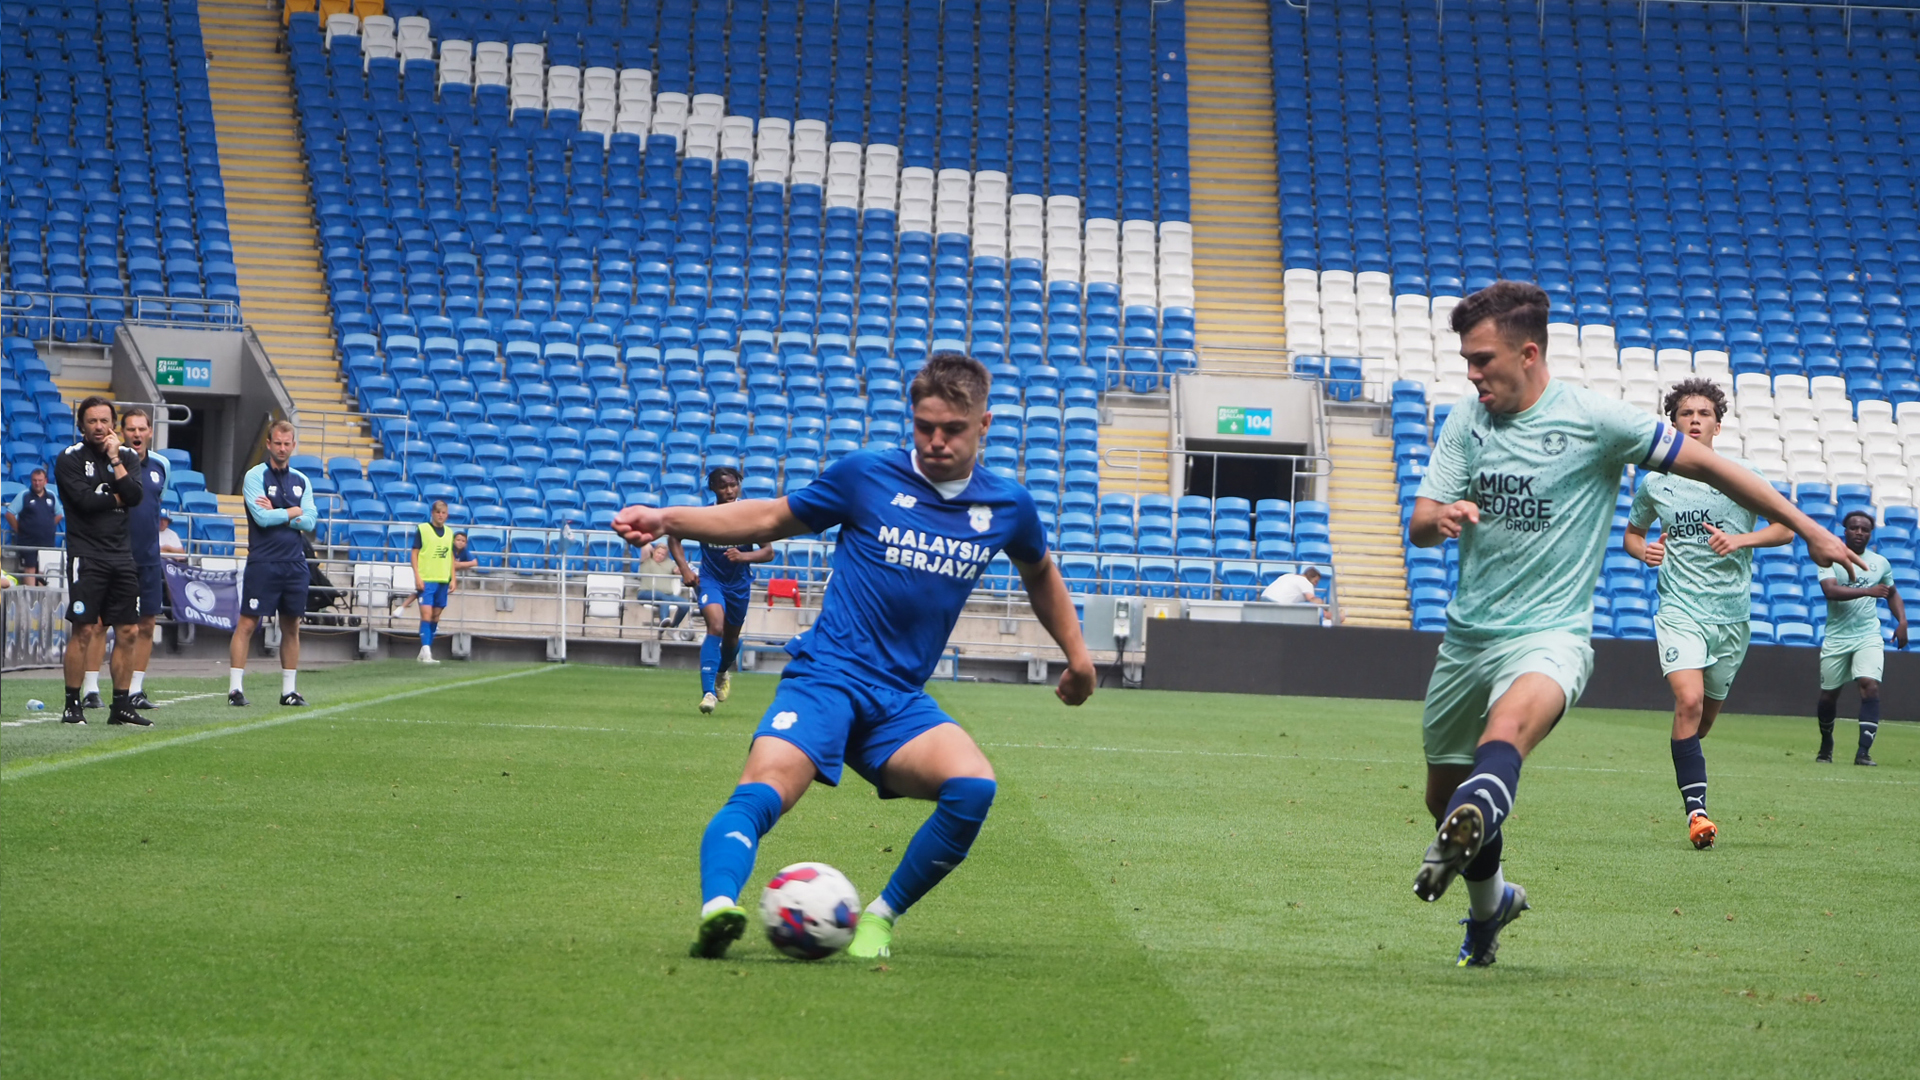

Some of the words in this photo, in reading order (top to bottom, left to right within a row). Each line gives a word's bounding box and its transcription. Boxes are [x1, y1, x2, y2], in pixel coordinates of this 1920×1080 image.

[186, 366, 209, 380] 103
[1246, 415, 1271, 429] 104
[1480, 471, 1535, 496] MICK
[1675, 508, 1711, 524] MICK
[1505, 518, 1551, 533] GROUP
[878, 525, 990, 563] MALAYSIA
[885, 546, 978, 580] BERJAYA
[200, 612, 232, 628] TOUR
